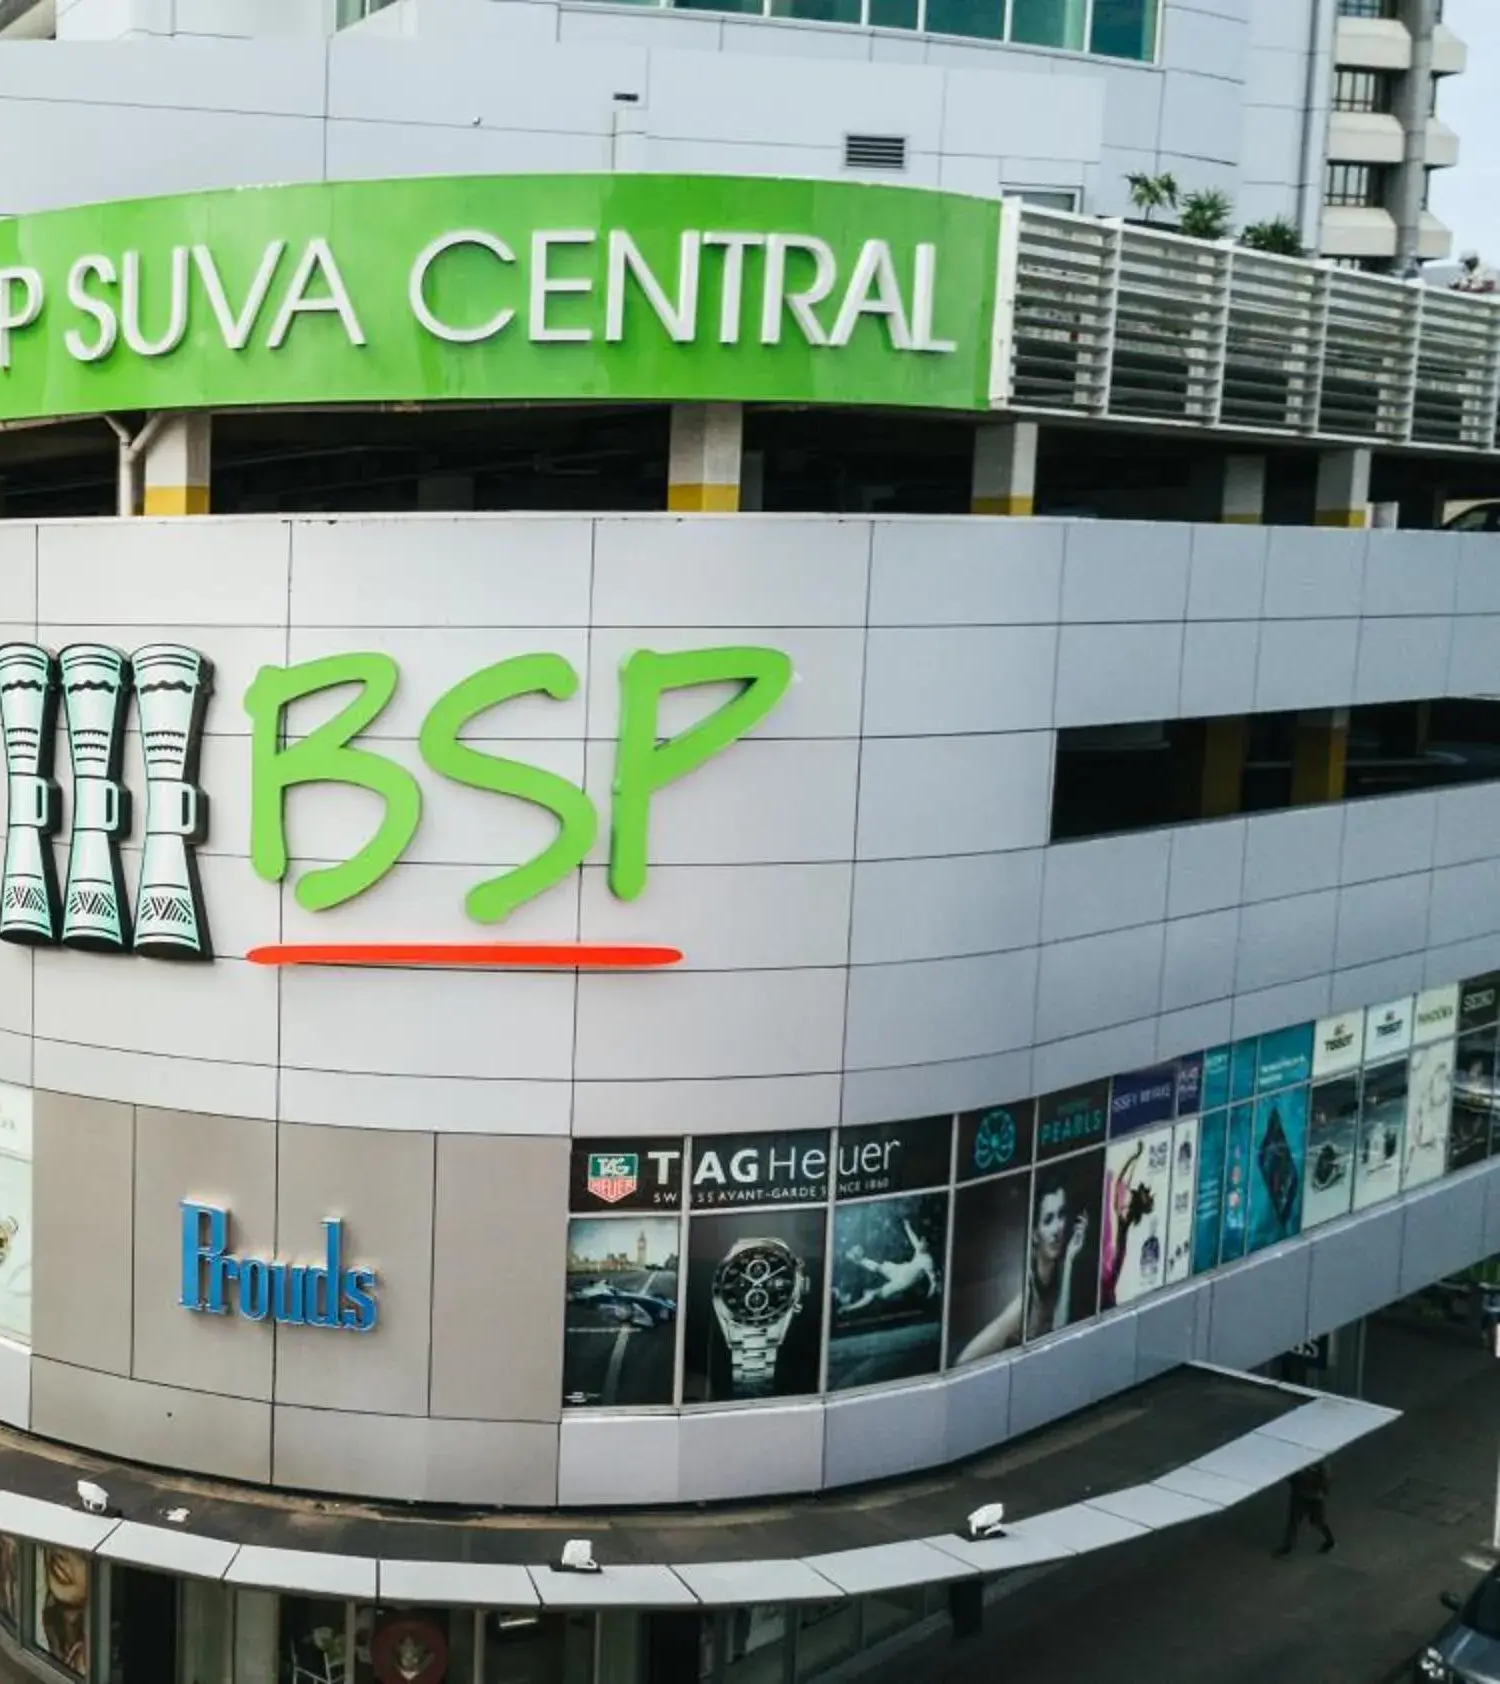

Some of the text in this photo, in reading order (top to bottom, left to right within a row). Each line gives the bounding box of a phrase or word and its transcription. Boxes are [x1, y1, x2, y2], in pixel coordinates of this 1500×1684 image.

[64, 237, 368, 362] SUVA
[409, 228, 960, 353] CENTRAL
[244, 646, 794, 926] BSP
[1041, 1108, 1103, 1147] PEARLS
[597, 1157, 630, 1177] TAG
[647, 1139, 901, 1185] TAG Heuer
[653, 1191, 714, 1204] SWSS
[717, 1185, 817, 1201] AVANT-GARDE
[821, 1180, 861, 1197] SNCE
[178, 1197, 378, 1332] Prouds
